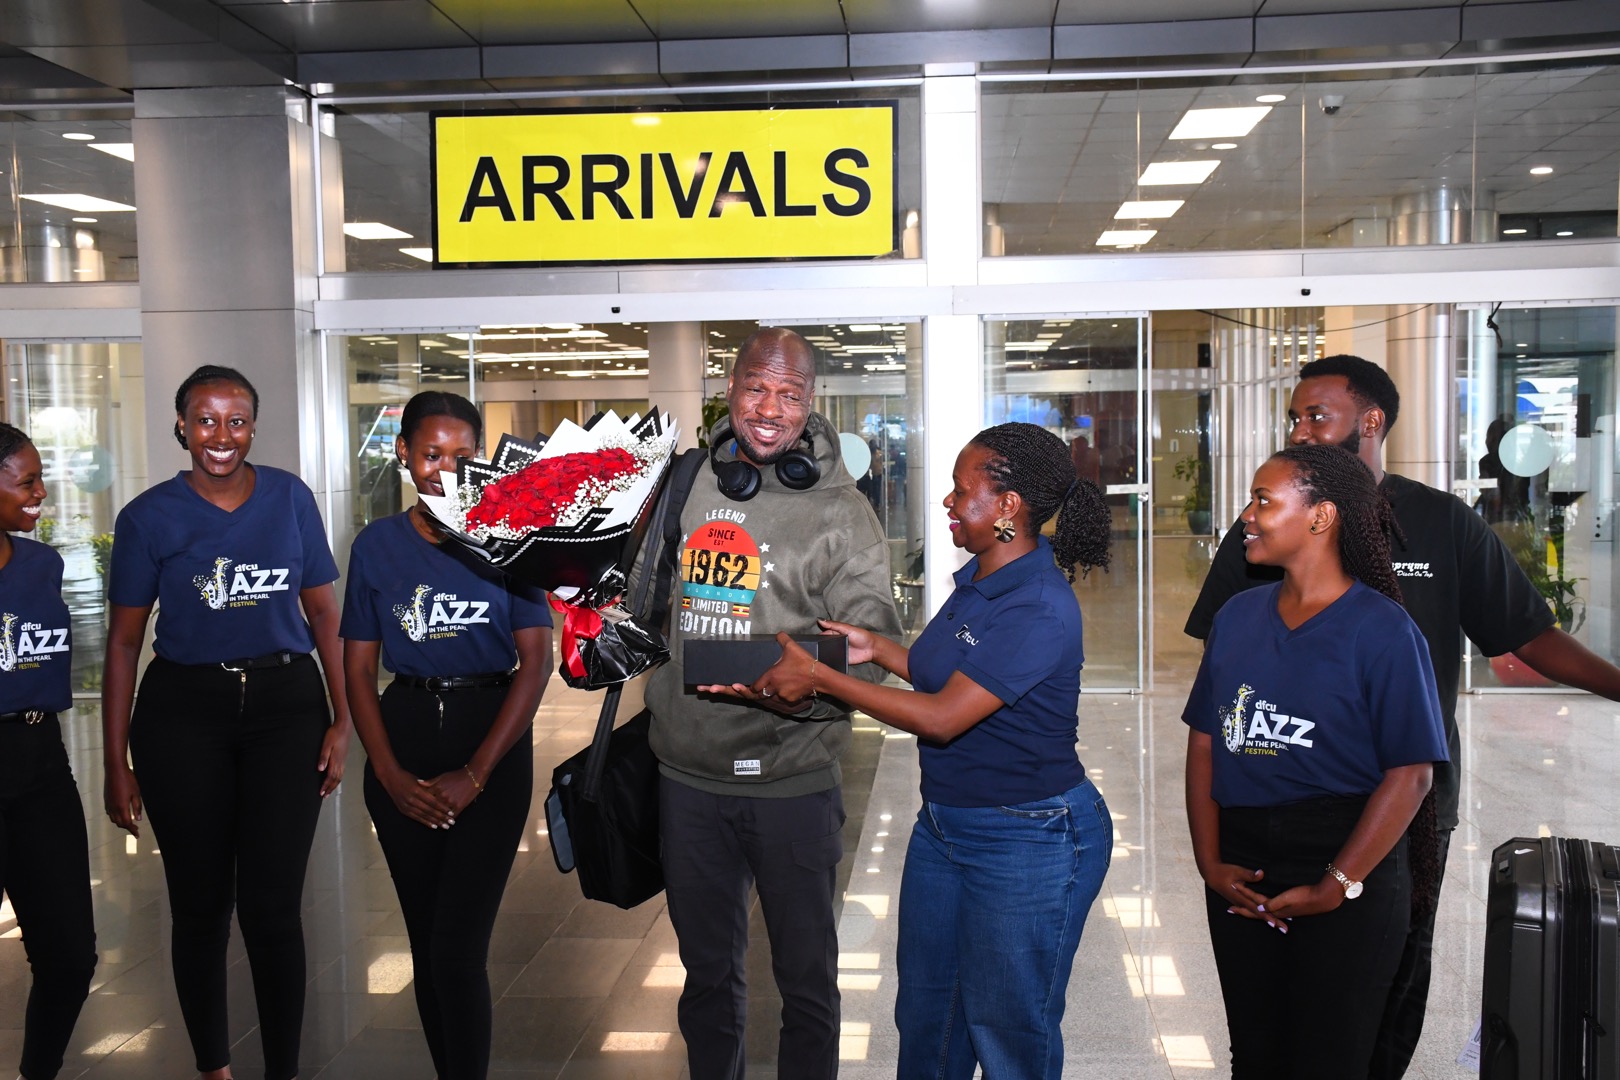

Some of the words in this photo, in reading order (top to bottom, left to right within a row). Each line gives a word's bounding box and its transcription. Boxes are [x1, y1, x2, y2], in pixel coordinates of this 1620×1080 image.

[459, 148, 871, 222] ARRIVALS
[706, 508, 746, 524] LEGEND
[708, 528, 735, 540] SINCE
[235, 564, 258, 572] dfcu
[688, 549, 749, 590] 1962
[1391, 562, 1430, 573] pryme
[433, 593, 457, 601] dfcu
[692, 598, 729, 614] LIMITED
[20, 622, 42, 631] dfcu
[450, 624, 469, 632] PEARL
[680, 611, 751, 635] EDITION
[430, 631, 458, 639] FESTIVAL
[34, 654, 52, 662] PEARL
[1255, 700, 1277, 712] dfcu
[1254, 740, 1269, 748] THE
[1245, 748, 1278, 756] FESTIVAL
